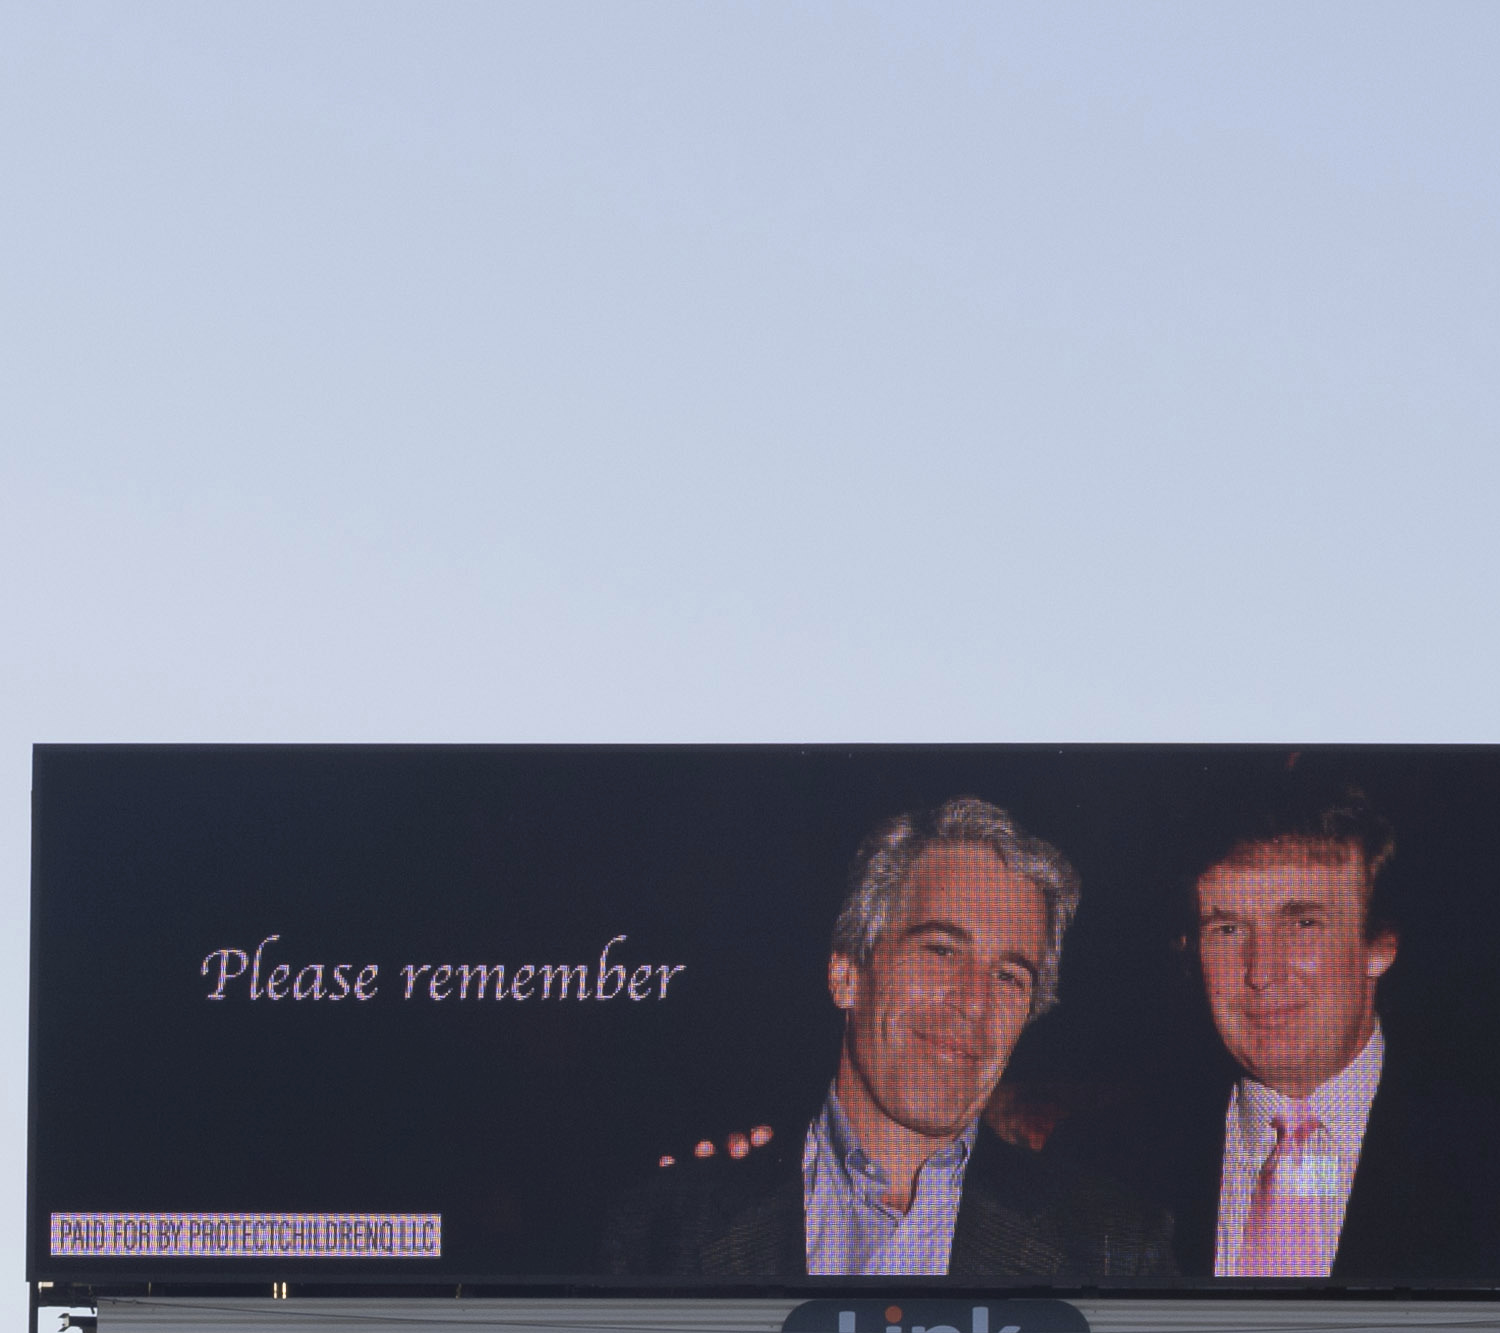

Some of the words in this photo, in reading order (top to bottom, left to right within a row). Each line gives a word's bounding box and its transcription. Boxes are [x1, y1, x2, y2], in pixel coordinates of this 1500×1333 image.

[200, 934, 379, 1000] Please
[400, 934, 687, 1000] remember
[60, 1219, 105, 1250] PAID
[113, 1219, 151, 1250] FOR
[156, 1219, 183, 1250] BY
[400, 1220, 434, 1251] LLC
